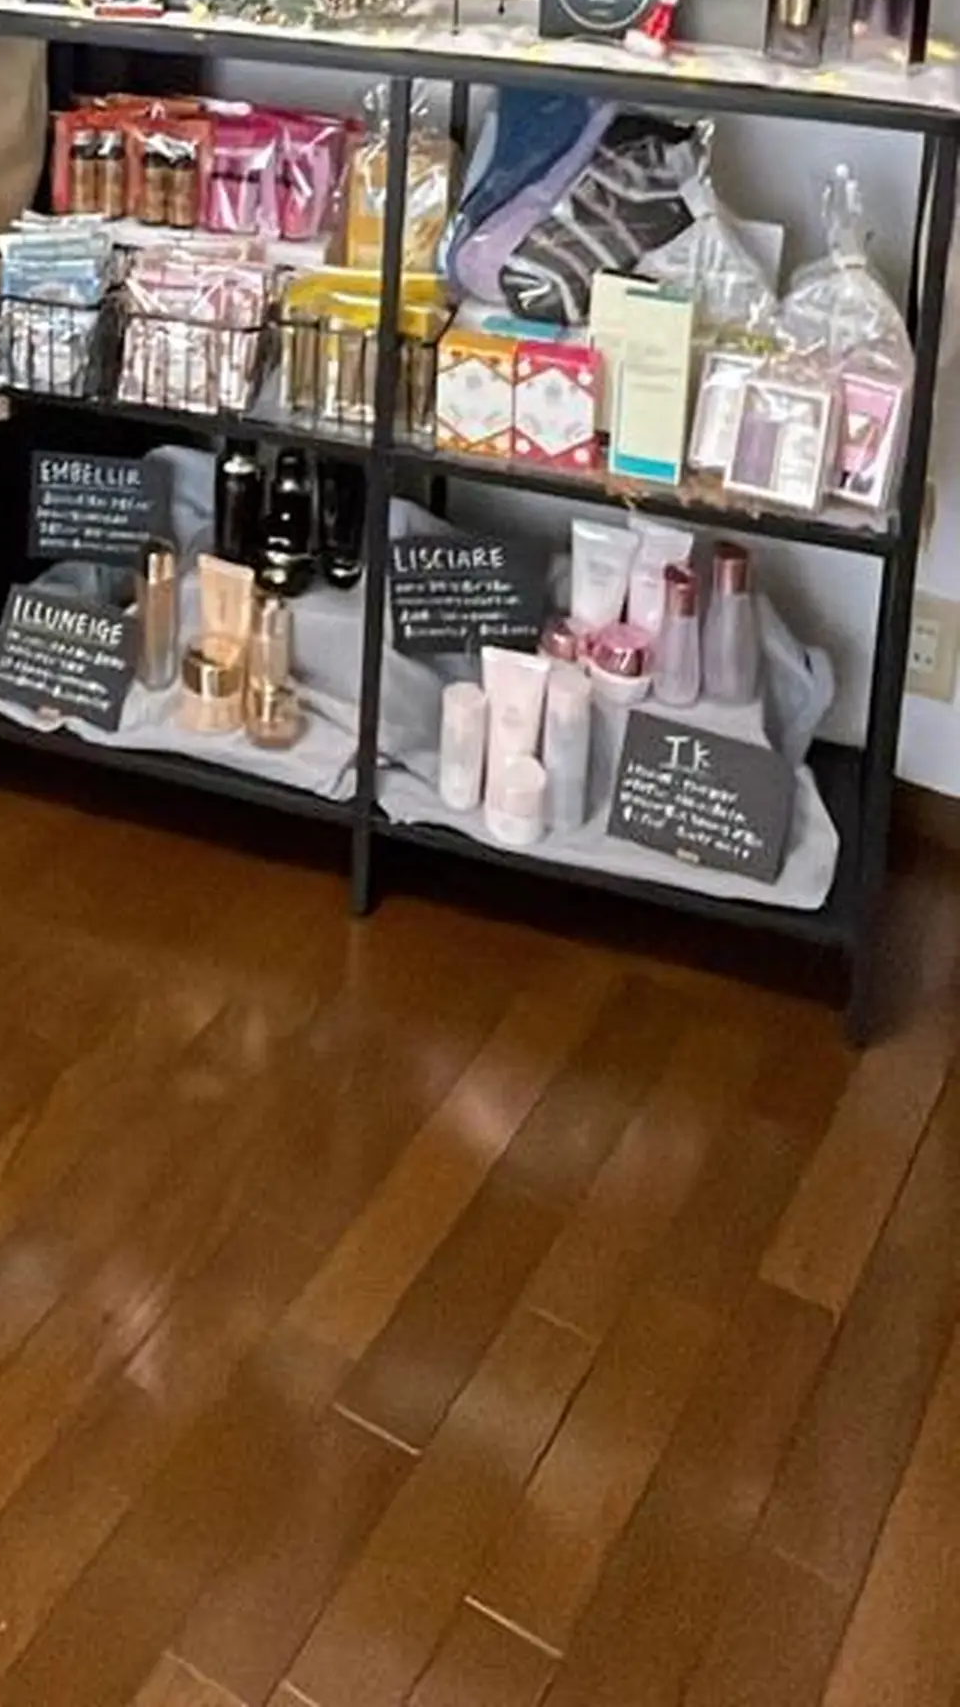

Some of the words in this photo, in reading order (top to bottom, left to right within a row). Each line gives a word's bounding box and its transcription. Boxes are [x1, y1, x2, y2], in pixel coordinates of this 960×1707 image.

[39, 459, 141, 486] EMBELLIR
[392, 545, 506, 573] LISCIARE
[11, 593, 123, 645] ILLUNEIGE
